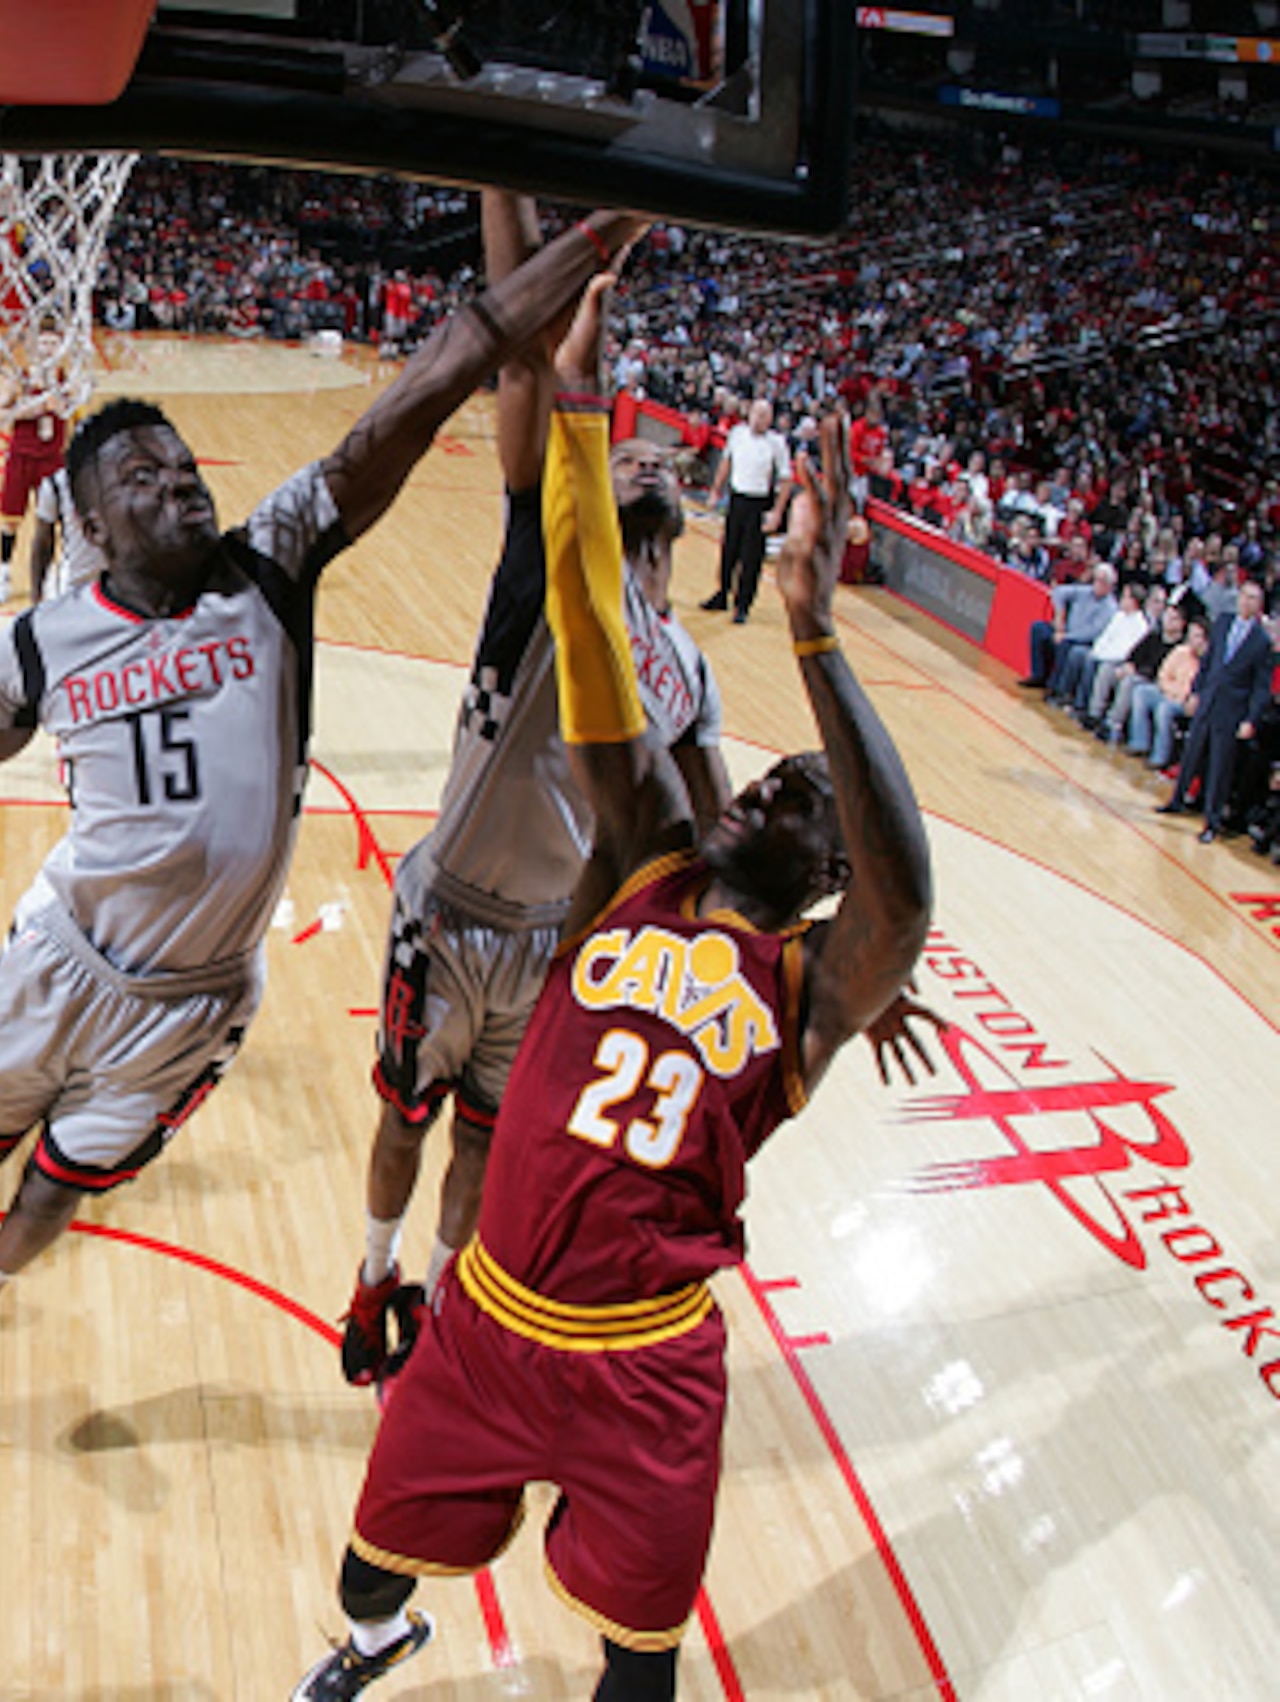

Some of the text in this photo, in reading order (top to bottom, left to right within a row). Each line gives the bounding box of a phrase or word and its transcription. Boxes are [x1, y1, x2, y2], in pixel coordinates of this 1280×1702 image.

[639, 33, 688, 68] NBA
[64, 637, 254, 723] ROCKETS
[124, 710, 200, 804] 15
[572, 924, 781, 1078] CAVS
[567, 1027, 705, 1168] 23
